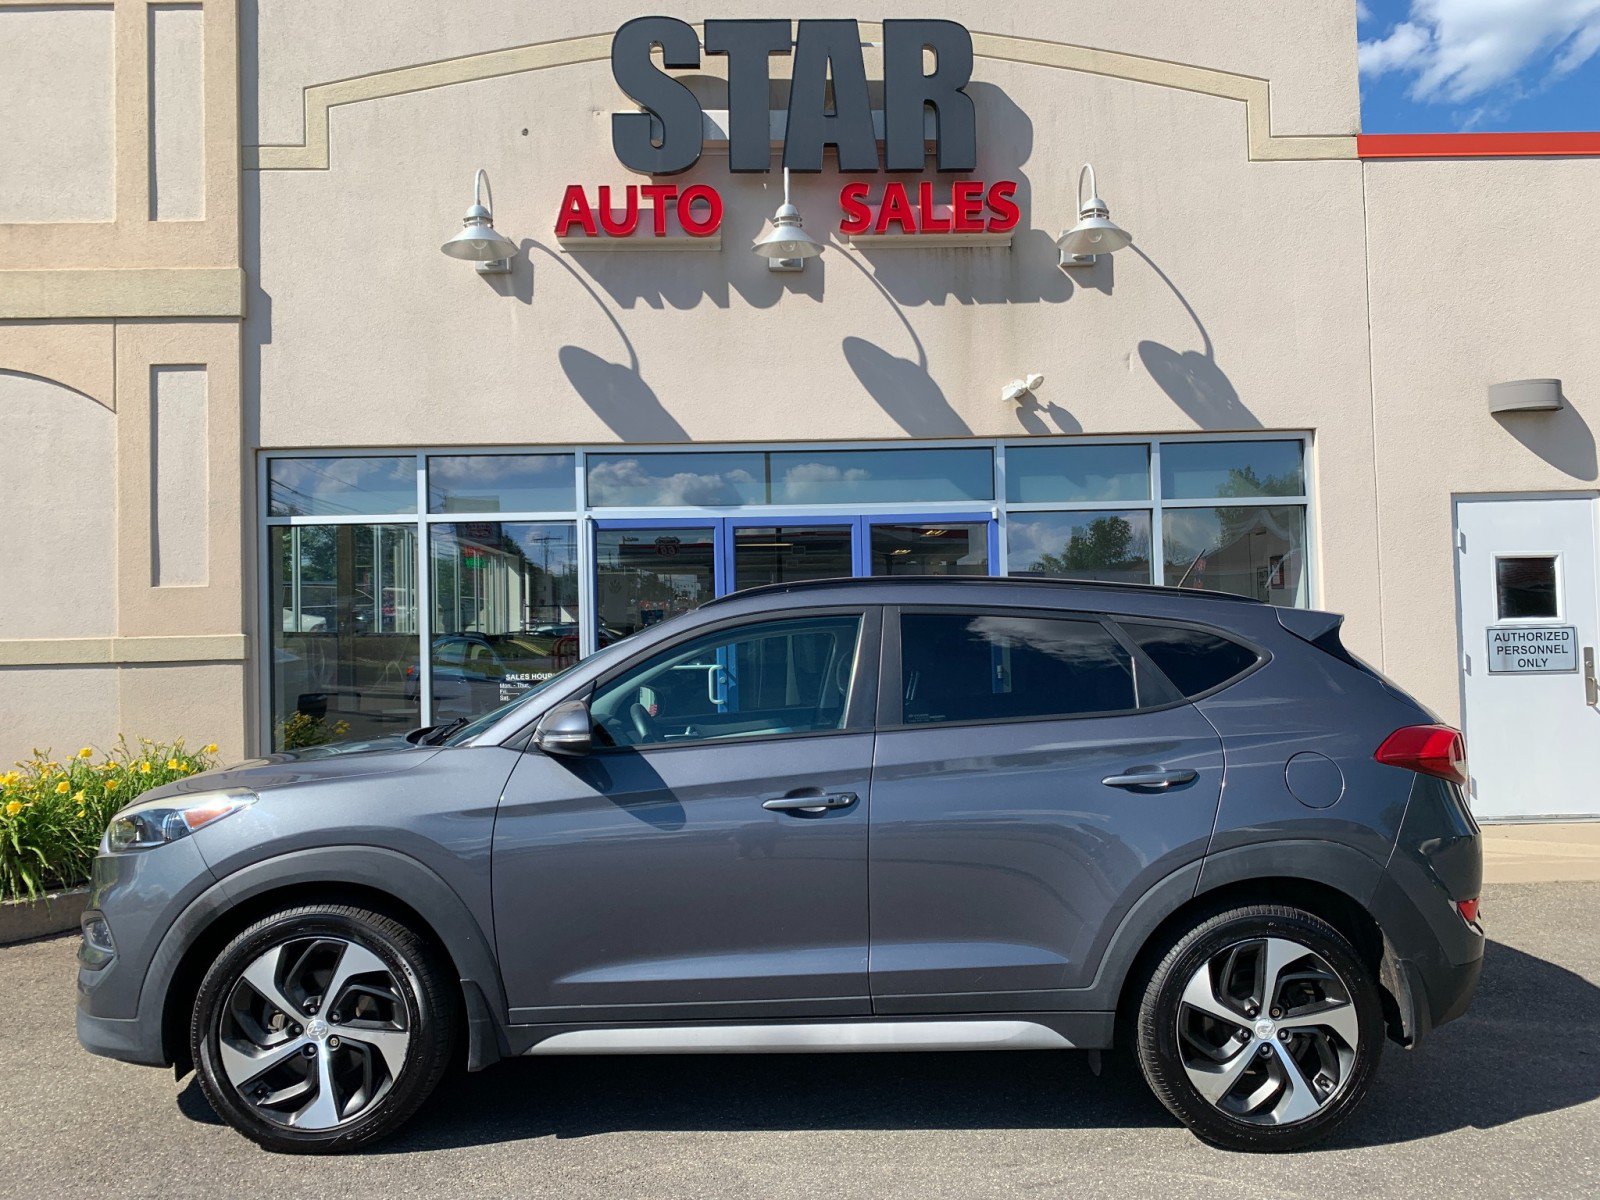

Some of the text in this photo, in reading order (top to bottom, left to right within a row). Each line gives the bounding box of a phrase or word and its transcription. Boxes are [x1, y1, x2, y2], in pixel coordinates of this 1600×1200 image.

[611, 16, 976, 175] STAR
[554, 181, 1021, 238] AUTO SALES
[1494, 631, 1570, 642] AUTHORIZED
[1496, 645, 1568, 655] PERSONNEL
[1517, 658, 1548, 668] ONLY
[505, 673, 530, 681] SALES
